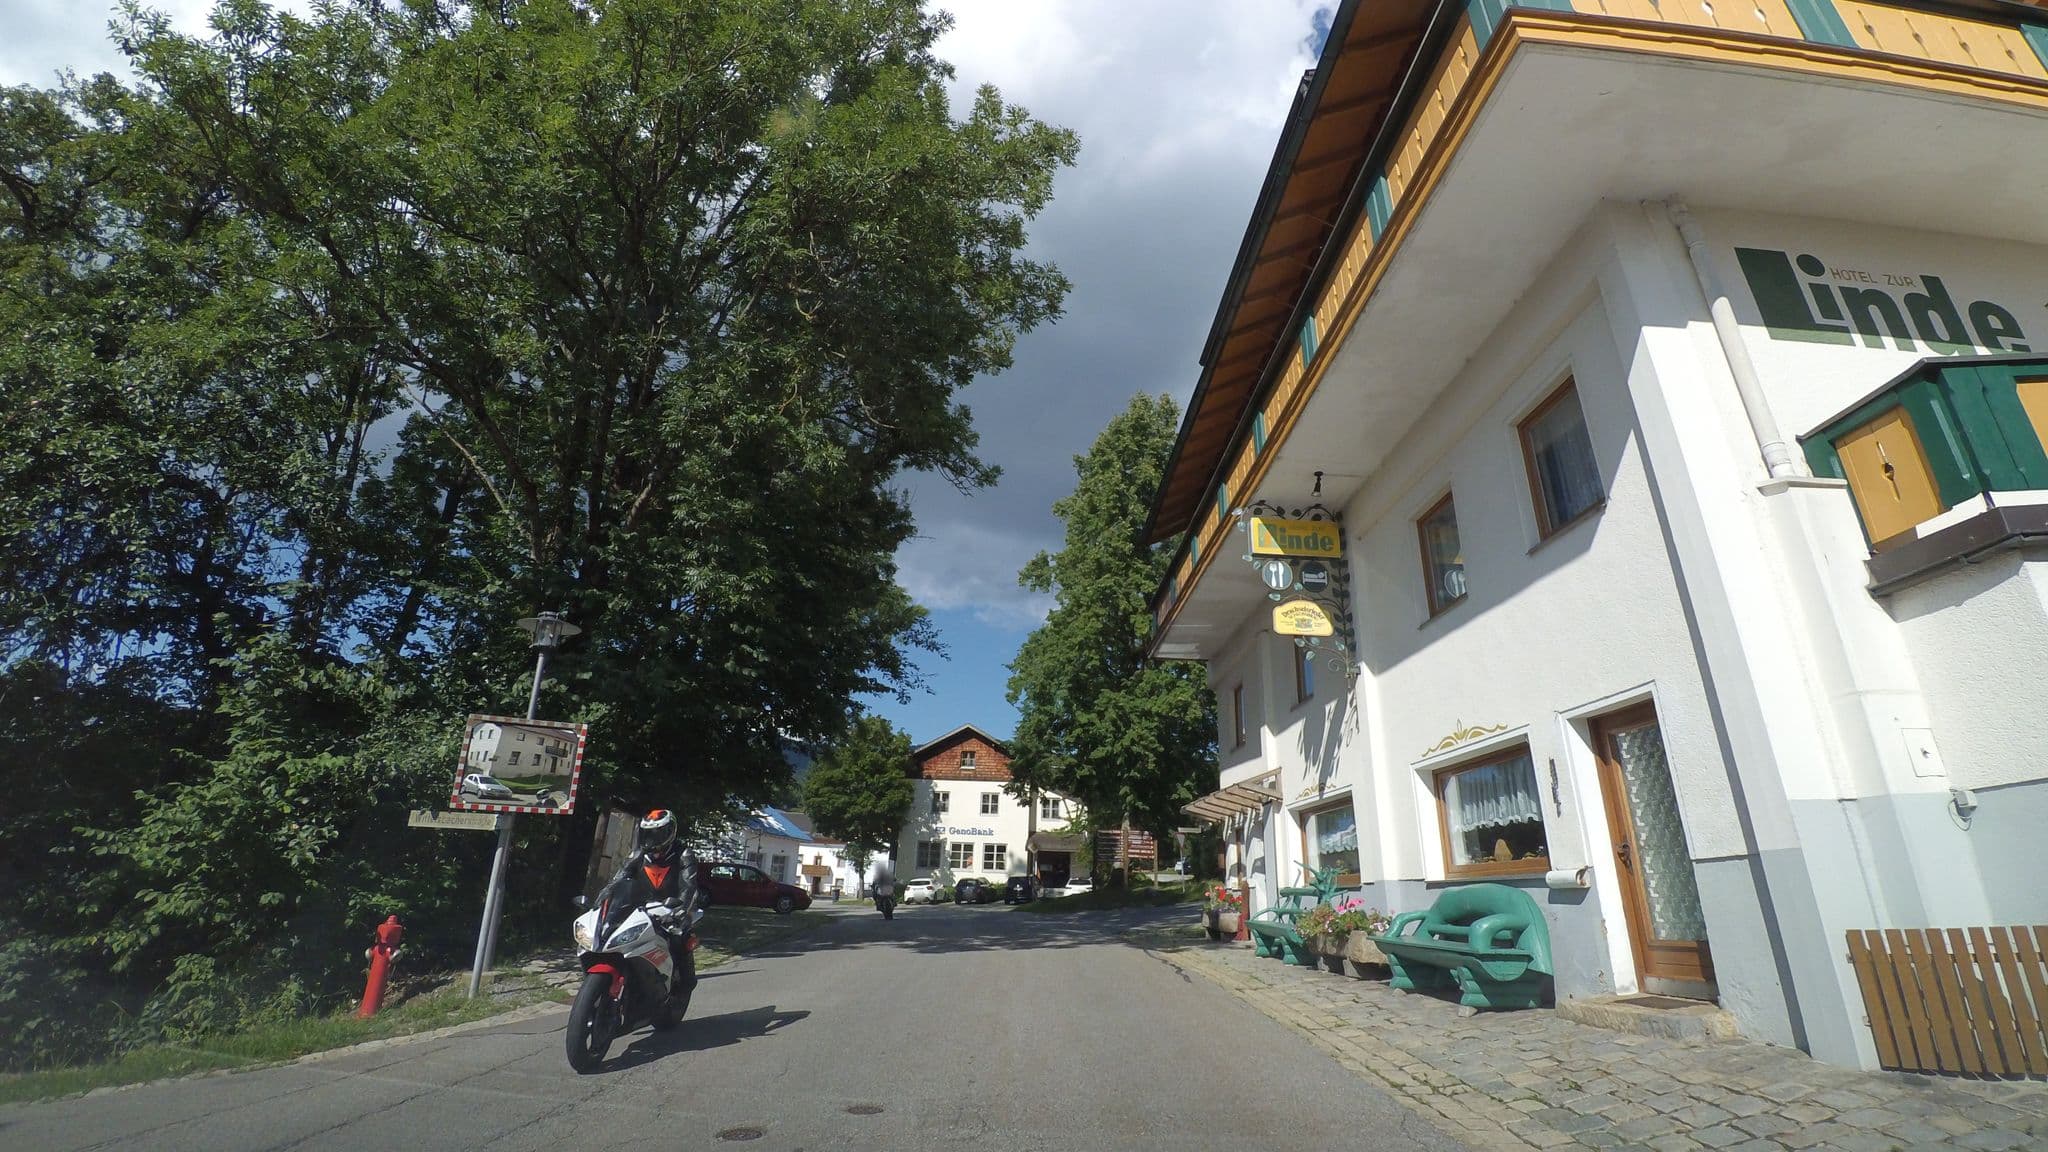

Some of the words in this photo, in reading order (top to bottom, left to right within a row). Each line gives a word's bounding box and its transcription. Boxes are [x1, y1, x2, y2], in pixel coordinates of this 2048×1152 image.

[1829, 267, 1878, 284] HOTEL
[1881, 274, 1917, 287] ZUR
[948, 826, 994, 836] GenoBank
